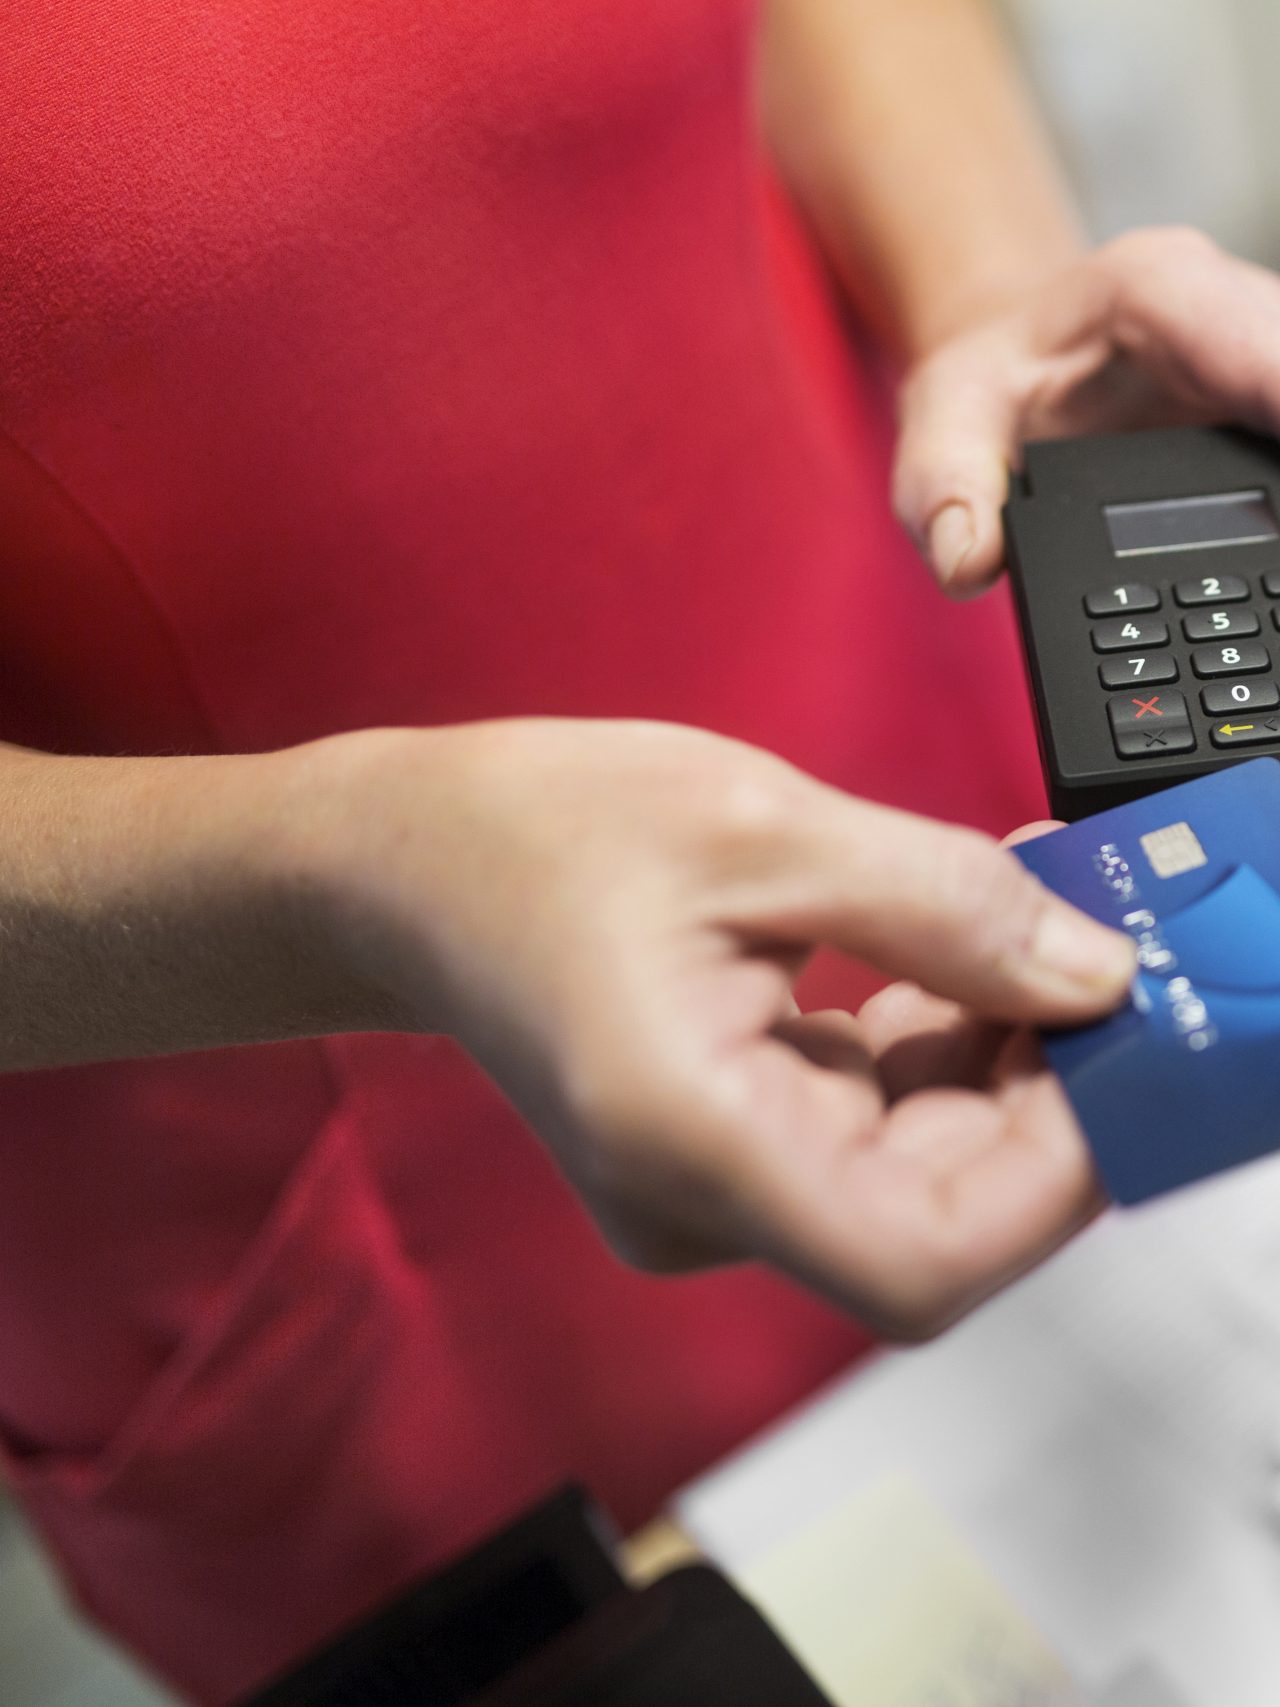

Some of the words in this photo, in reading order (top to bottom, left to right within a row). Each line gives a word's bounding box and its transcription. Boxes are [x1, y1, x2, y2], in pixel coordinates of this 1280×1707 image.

[1113, 587, 1129, 605] 1
[1201, 577, 1222, 597] 2
[1120, 622, 1141, 640] 4
[1211, 612, 1231, 631] 5
[1127, 658, 1146, 676] 7
[1221, 647, 1241, 665] 8
[1230, 684, 1251, 703] 0
